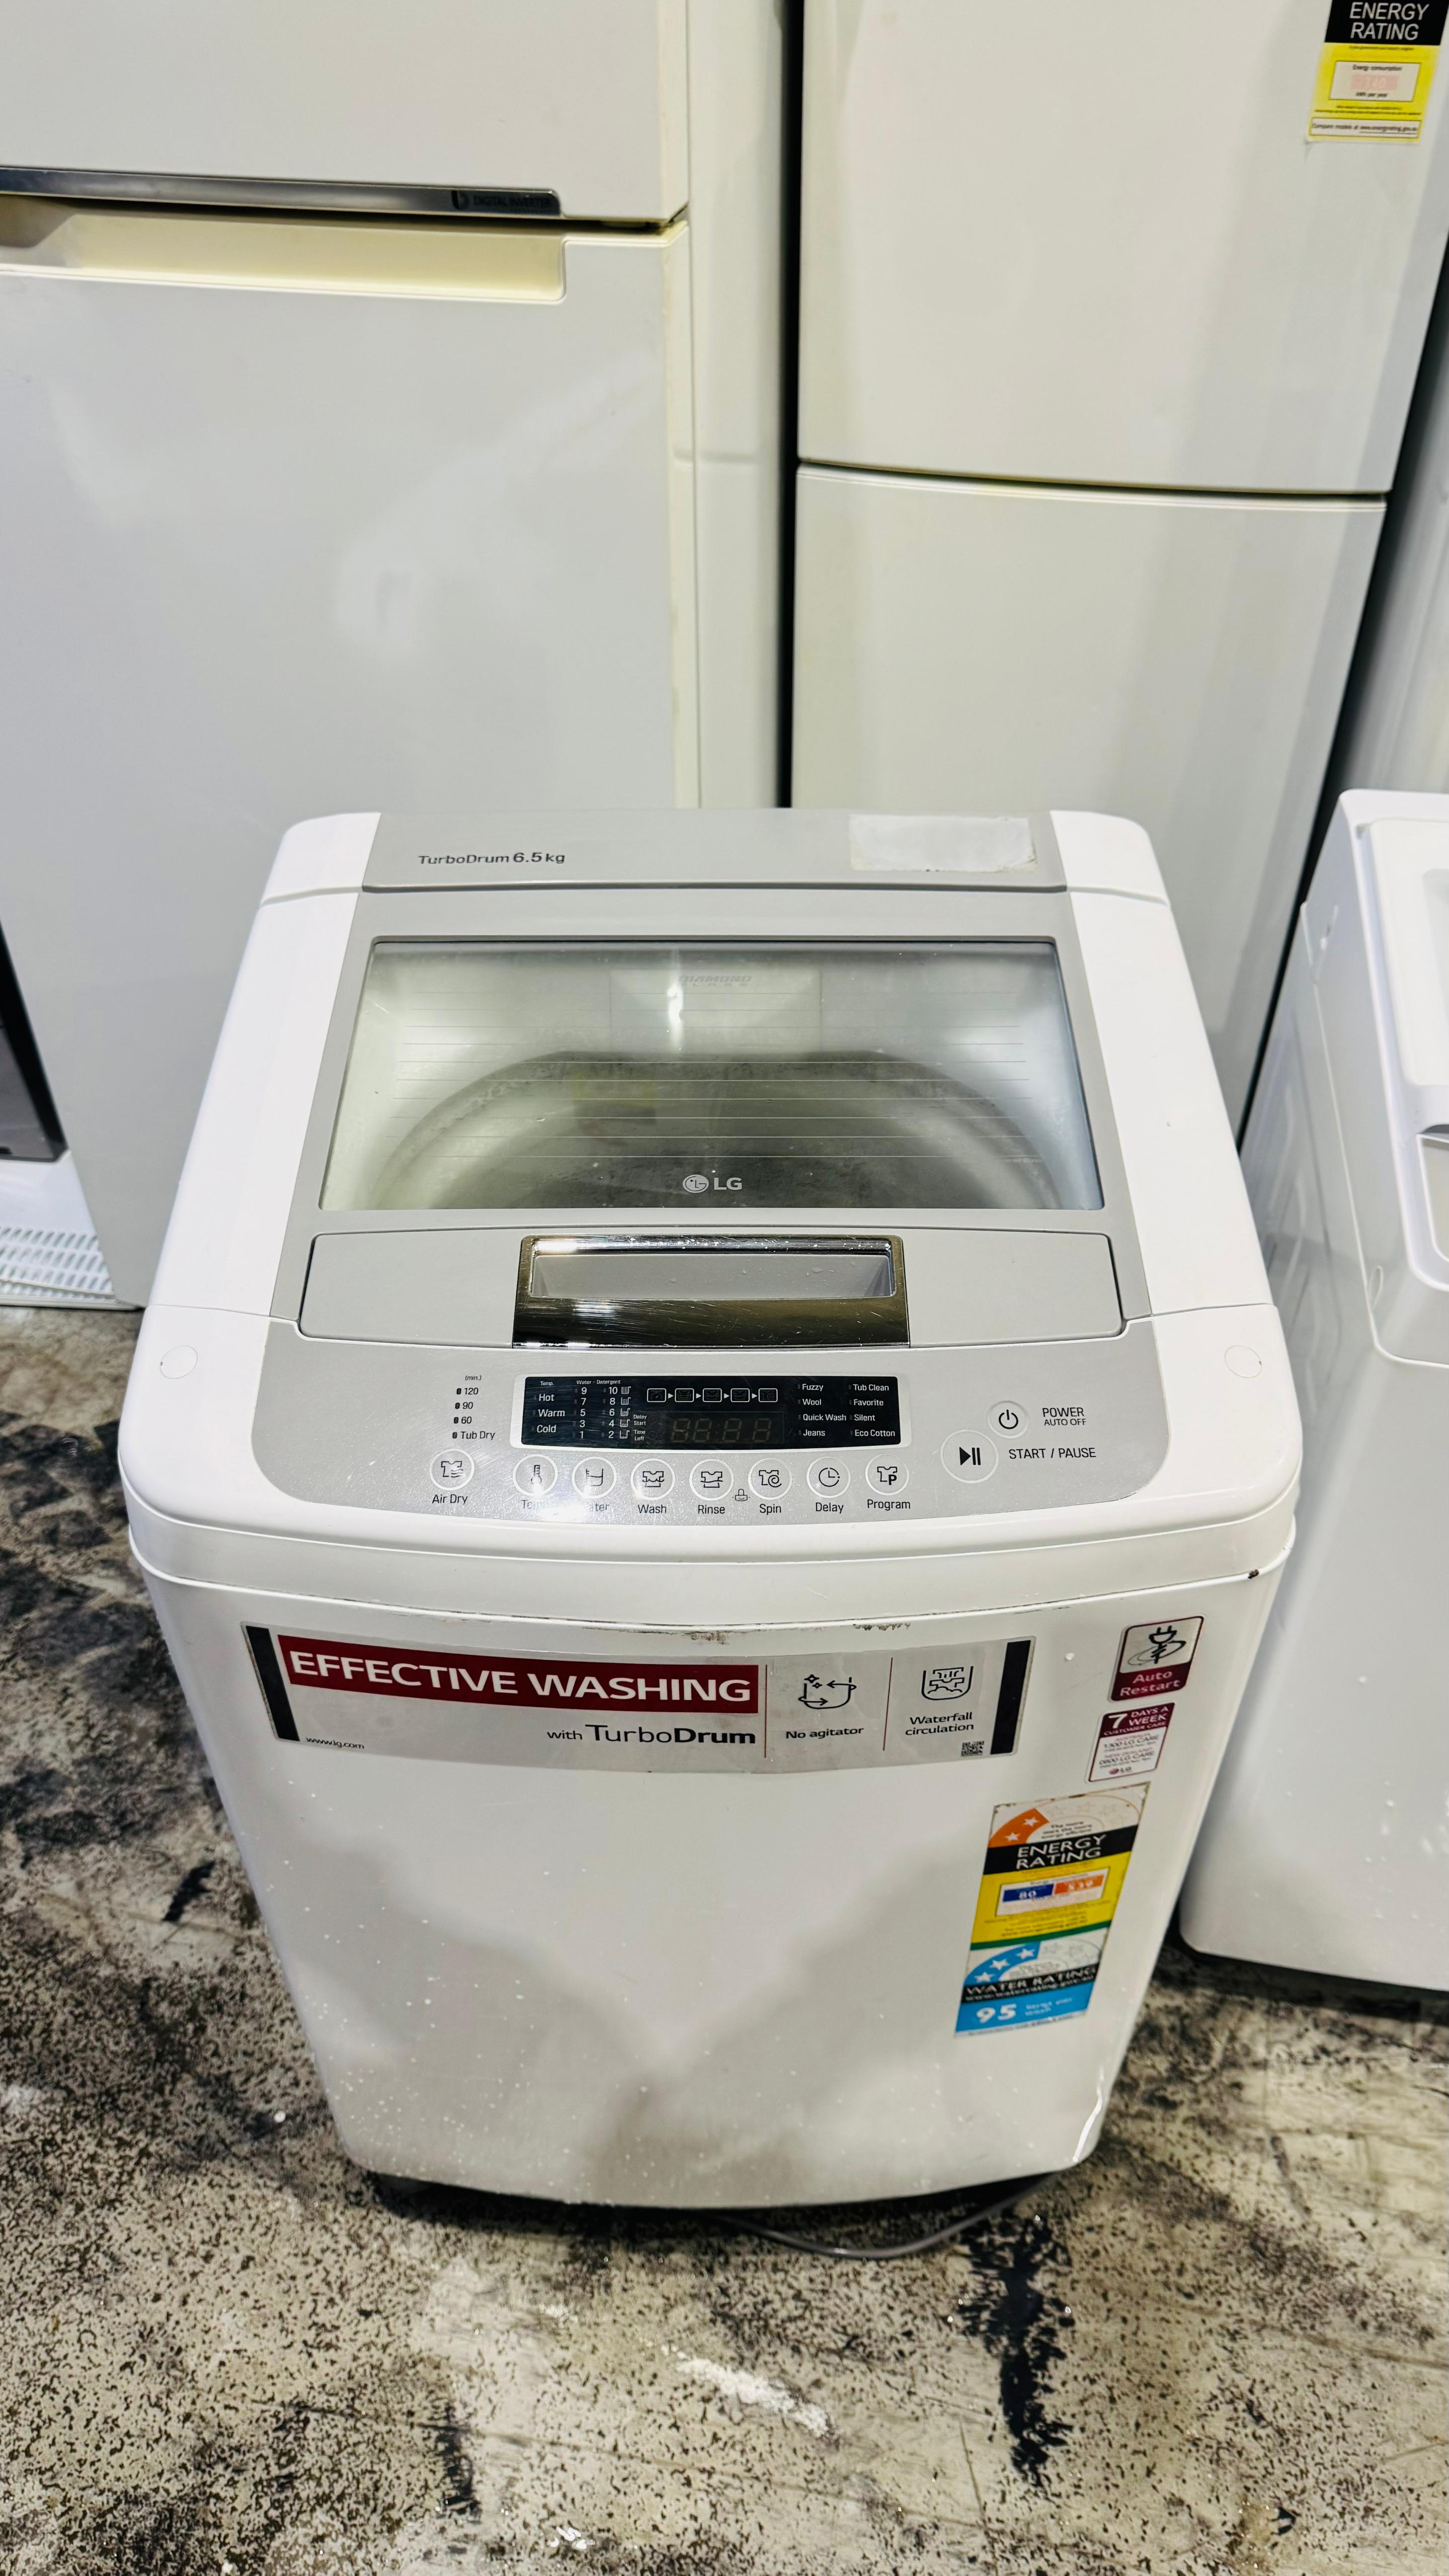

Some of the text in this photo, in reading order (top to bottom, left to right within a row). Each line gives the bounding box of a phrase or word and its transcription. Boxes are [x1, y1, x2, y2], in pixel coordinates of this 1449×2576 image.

[1349, 2, 1429, 20] ENERGY
[1350, 22, 1419, 40] RATING
[419, 855, 509, 864] TurboDrum
[714, 1177, 742, 1190] LG
[464, 1387, 479, 1395] 120
[802, 1384, 824, 1392] Fuzzy
[539, 1394, 554, 1402] Hot
[462, 1402, 473, 1410] 90
[1042, 1407, 1084, 1417] POWER
[461, 1416, 472, 1424] 60
[537, 1425, 556, 1433] Cold
[460, 1431, 496, 1441] Tub Dry
[580, 1431, 614, 1439] 1 2
[1009, 1448, 1046, 1459] START
[1058, 1447, 1097, 1458] PAUSE
[432, 1494, 468, 1505] Air Dry
[867, 1499, 911, 1510] Program
[583, 1502, 610, 1512] ater
[638, 1504, 667, 1514] Wash
[698, 1505, 726, 1514] Rinse
[760, 1504, 782, 1513] Spin
[816, 1502, 844, 1513] Delay
[289, 1651, 751, 1702] EFFECTIVE WASHING
[1133, 1671, 1173, 1684] Auto
[1119, 1679, 1181, 1697] Restart
[910, 1712, 973, 1725] Waterfall
[1131, 1708, 1159, 1718] DAYS
[1108, 1713, 1128, 1729] 7
[1128, 1713, 1168, 1726] WEEK
[547, 1724, 755, 1744] with TurboDrum
[786, 1726, 864, 1739] No agitator
[905, 1723, 974, 1736] circulation
[1104, 1725, 1146, 1736] CUSTOMER
[306, 1737, 364, 1749] www.lg.com
[1018, 1834, 1106, 1858] ENERGY
[1016, 1847, 1102, 1870] RATING
[966, 1979, 1027, 1995] WATER
[976, 2003, 1017, 2023] 95
